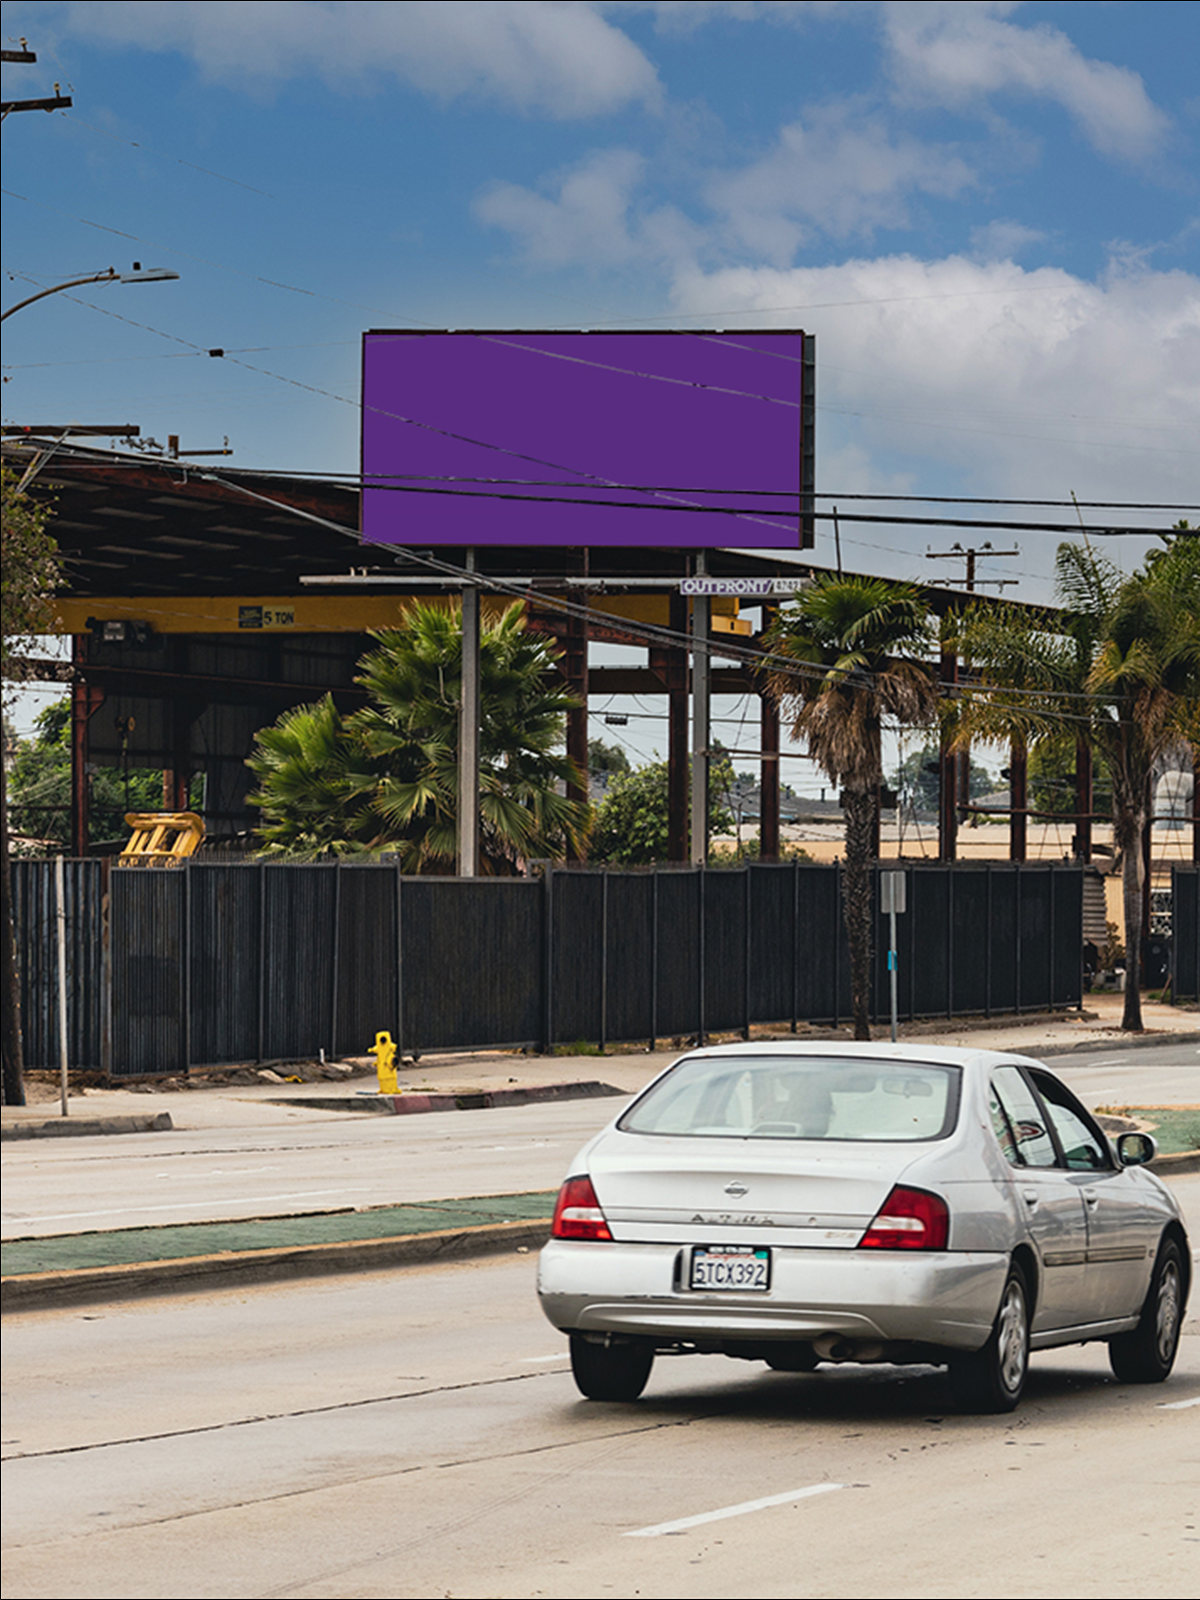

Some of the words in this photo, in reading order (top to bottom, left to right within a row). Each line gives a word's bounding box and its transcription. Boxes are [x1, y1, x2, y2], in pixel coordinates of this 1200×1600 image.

[264, 611, 272, 625] 5
[275, 611, 294, 625] TON
[695, 1262, 766, 1284] 5TCX392
